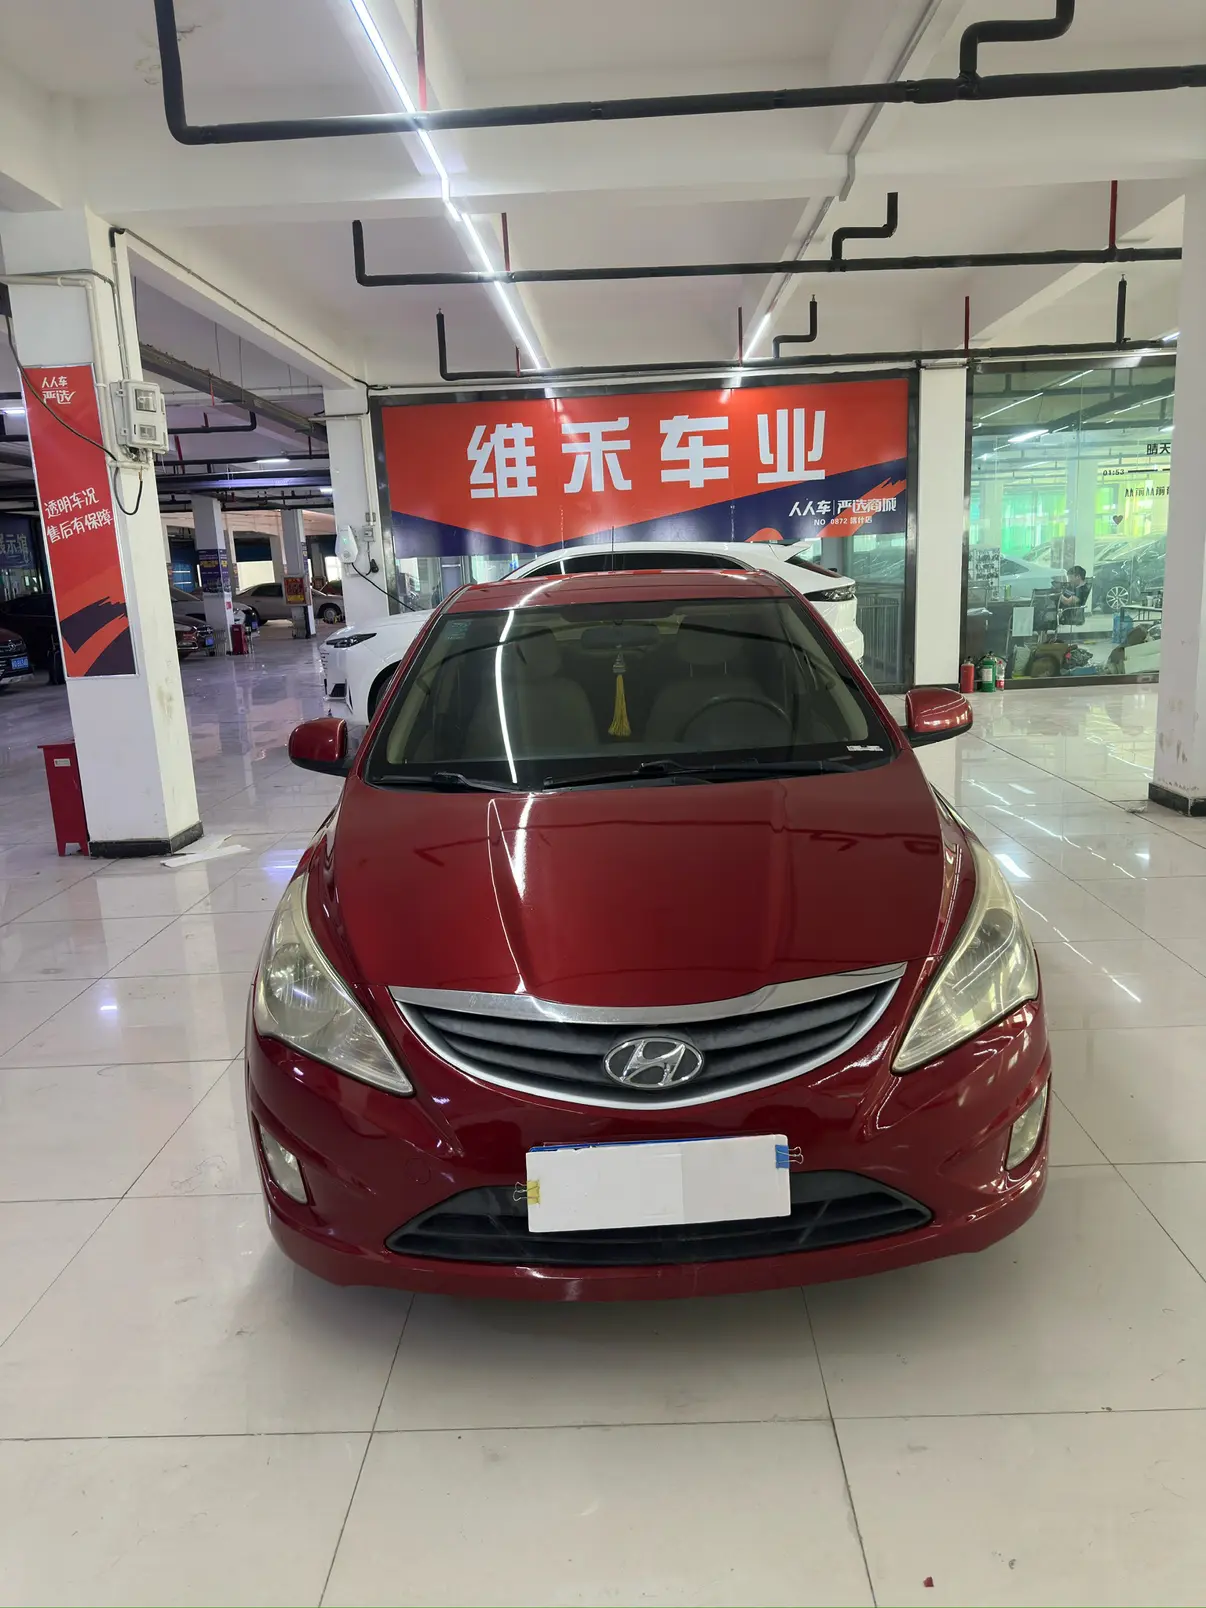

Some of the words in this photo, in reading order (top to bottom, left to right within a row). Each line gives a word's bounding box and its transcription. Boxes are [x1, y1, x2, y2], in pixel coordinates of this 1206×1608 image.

[42, 375, 68, 389] 人人车
[42, 389, 76, 405] 严选
[466, 408, 826, 499] 维禾车业
[44, 487, 99, 519] 透明车况
[789, 499, 831, 517] 人人车
[837, 497, 897, 514] 严选商城
[46, 508, 113, 544] 售后有保障
[813, 518, 826, 526] NO
[830, 517, 848, 525] 0872
